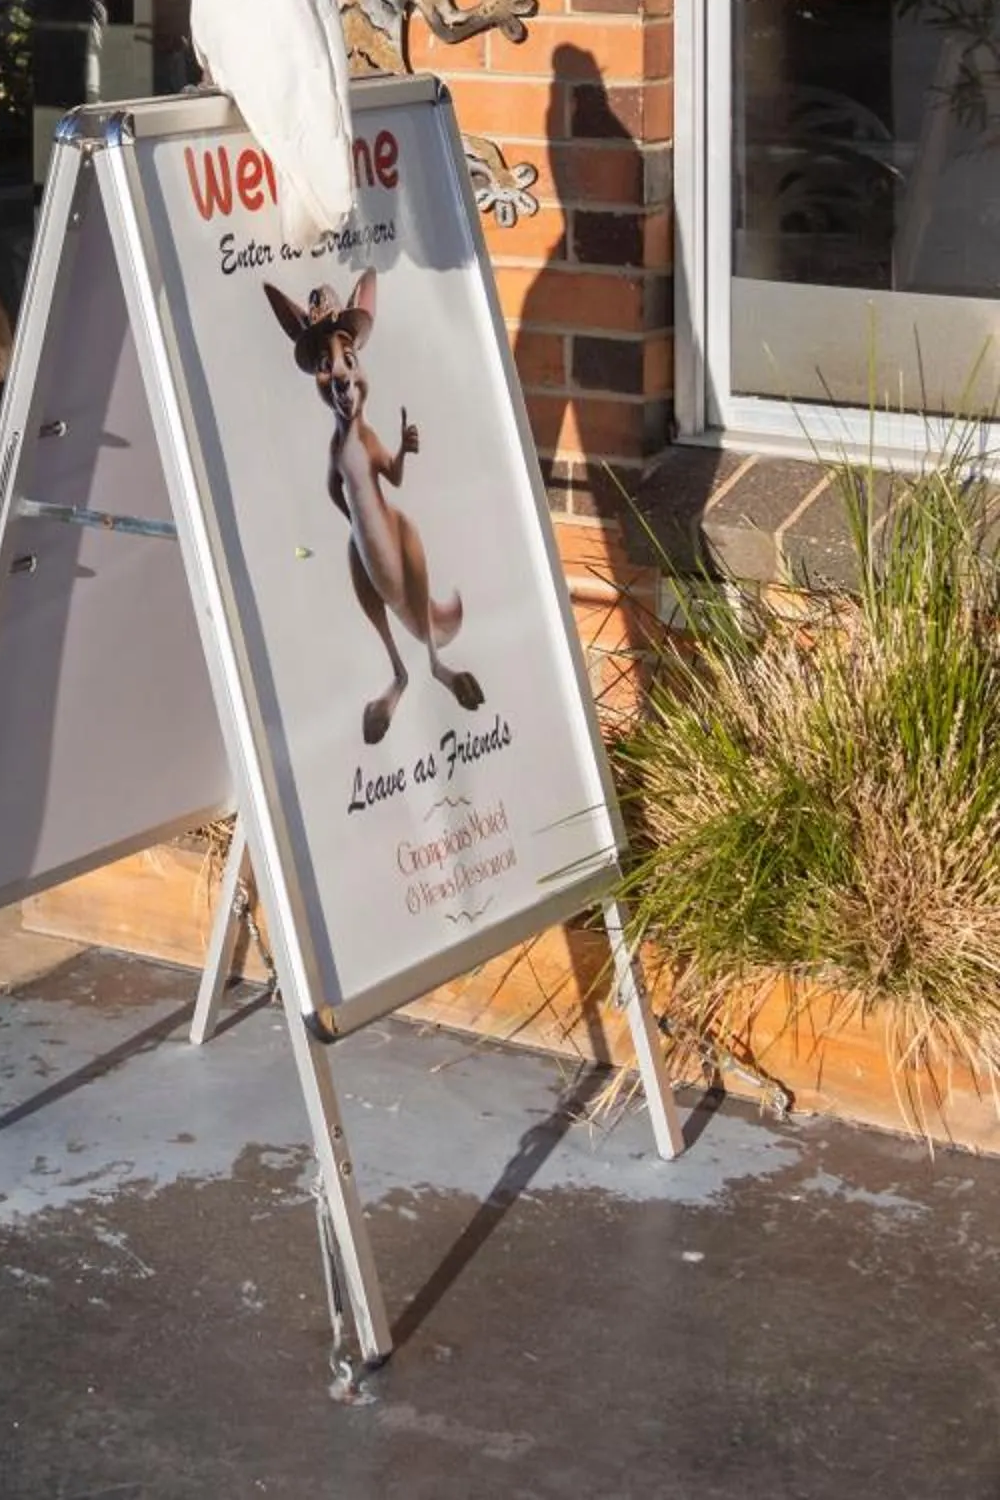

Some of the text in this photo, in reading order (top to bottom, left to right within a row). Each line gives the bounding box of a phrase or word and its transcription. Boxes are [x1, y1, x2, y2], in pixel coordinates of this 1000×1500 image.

[184, 130, 399, 221] Welme
[219, 232, 274, 275] Enter
[347, 714, 512, 815] Leave as Friends
